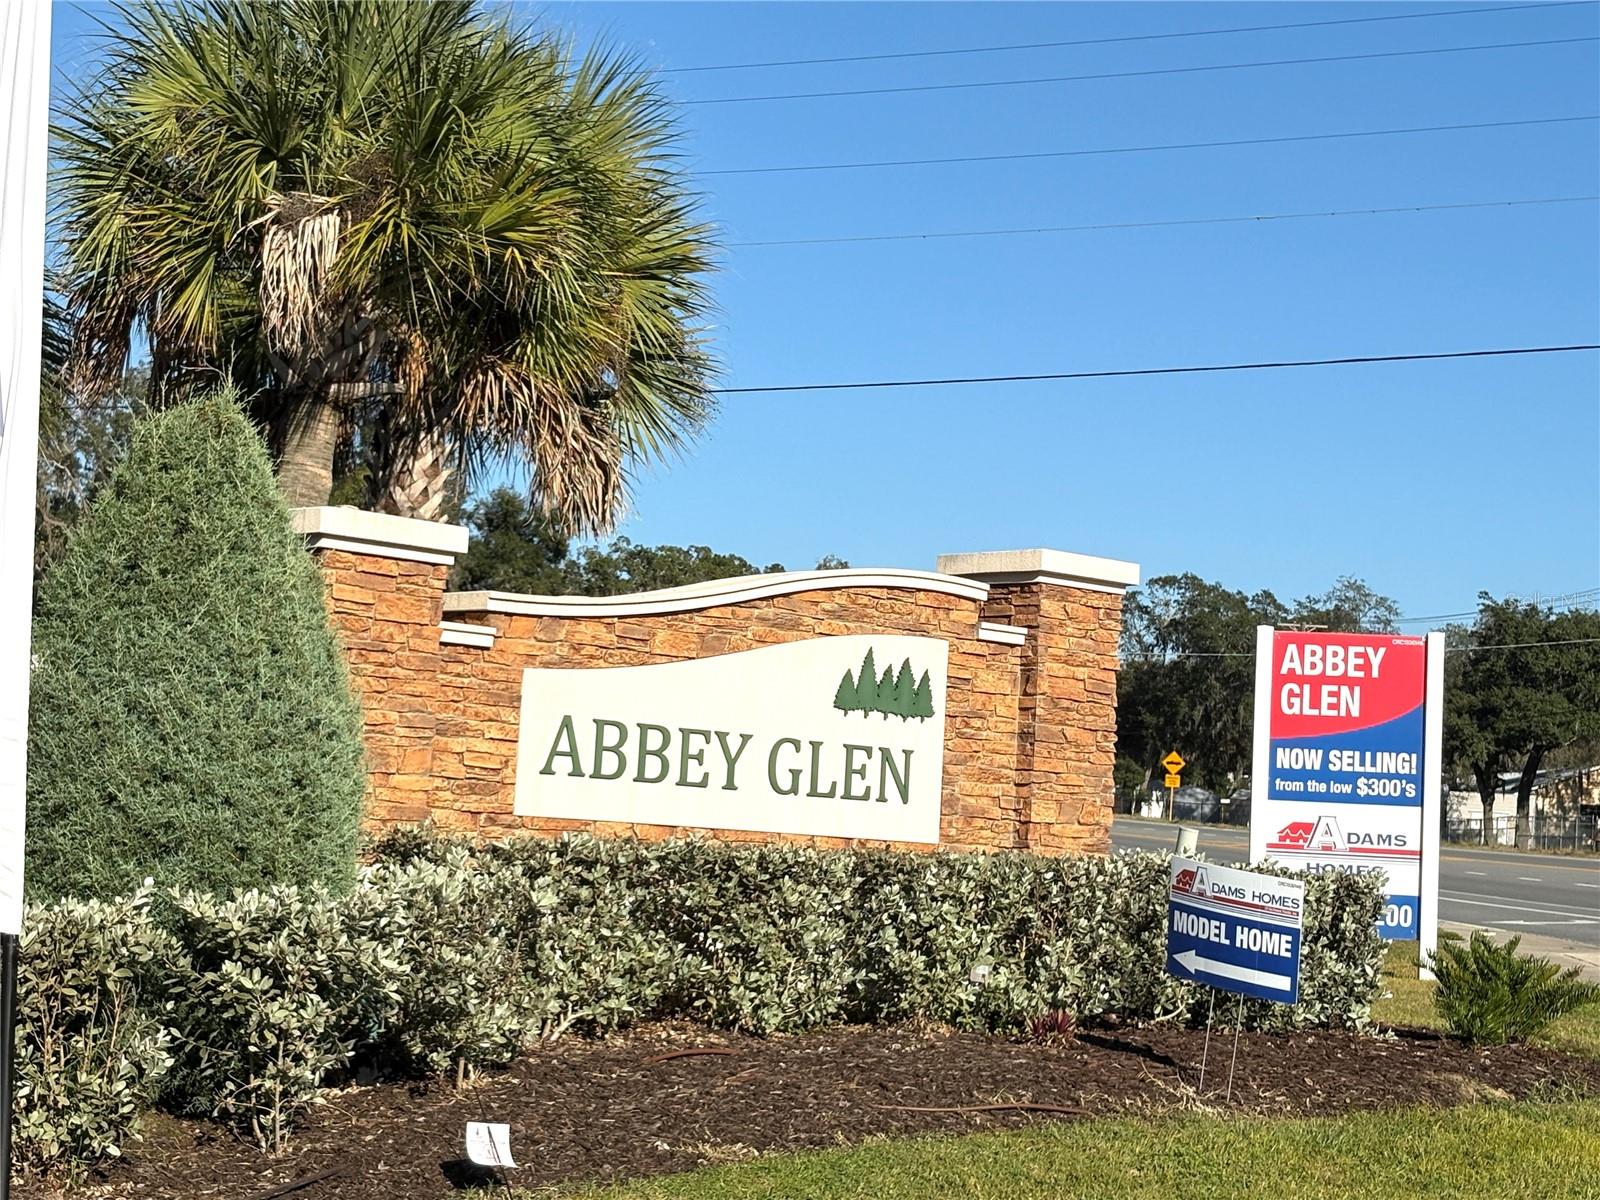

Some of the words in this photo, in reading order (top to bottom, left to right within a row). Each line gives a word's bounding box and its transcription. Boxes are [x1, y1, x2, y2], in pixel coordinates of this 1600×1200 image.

[1280, 643, 1386, 678] ABBEY
[1280, 683, 1361, 717] GLEN
[539, 715, 753, 790] ABBEY
[768, 737, 915, 805] GLEN
[1276, 748, 1323, 770] NOW
[1328, 750, 1417, 775] SELLING!
[1275, 778, 1304, 791] from
[1307, 780, 1327, 793] the
[1330, 781, 1352, 793] low
[1356, 776, 1416, 798] $300's
[1306, 816, 1408, 852] ADAMS
[1189, 866, 1246, 899] ADAMS
[1252, 891, 1300, 909] HOMES
[1173, 910, 1230, 945] MODEL
[1235, 925, 1293, 958] HOME
